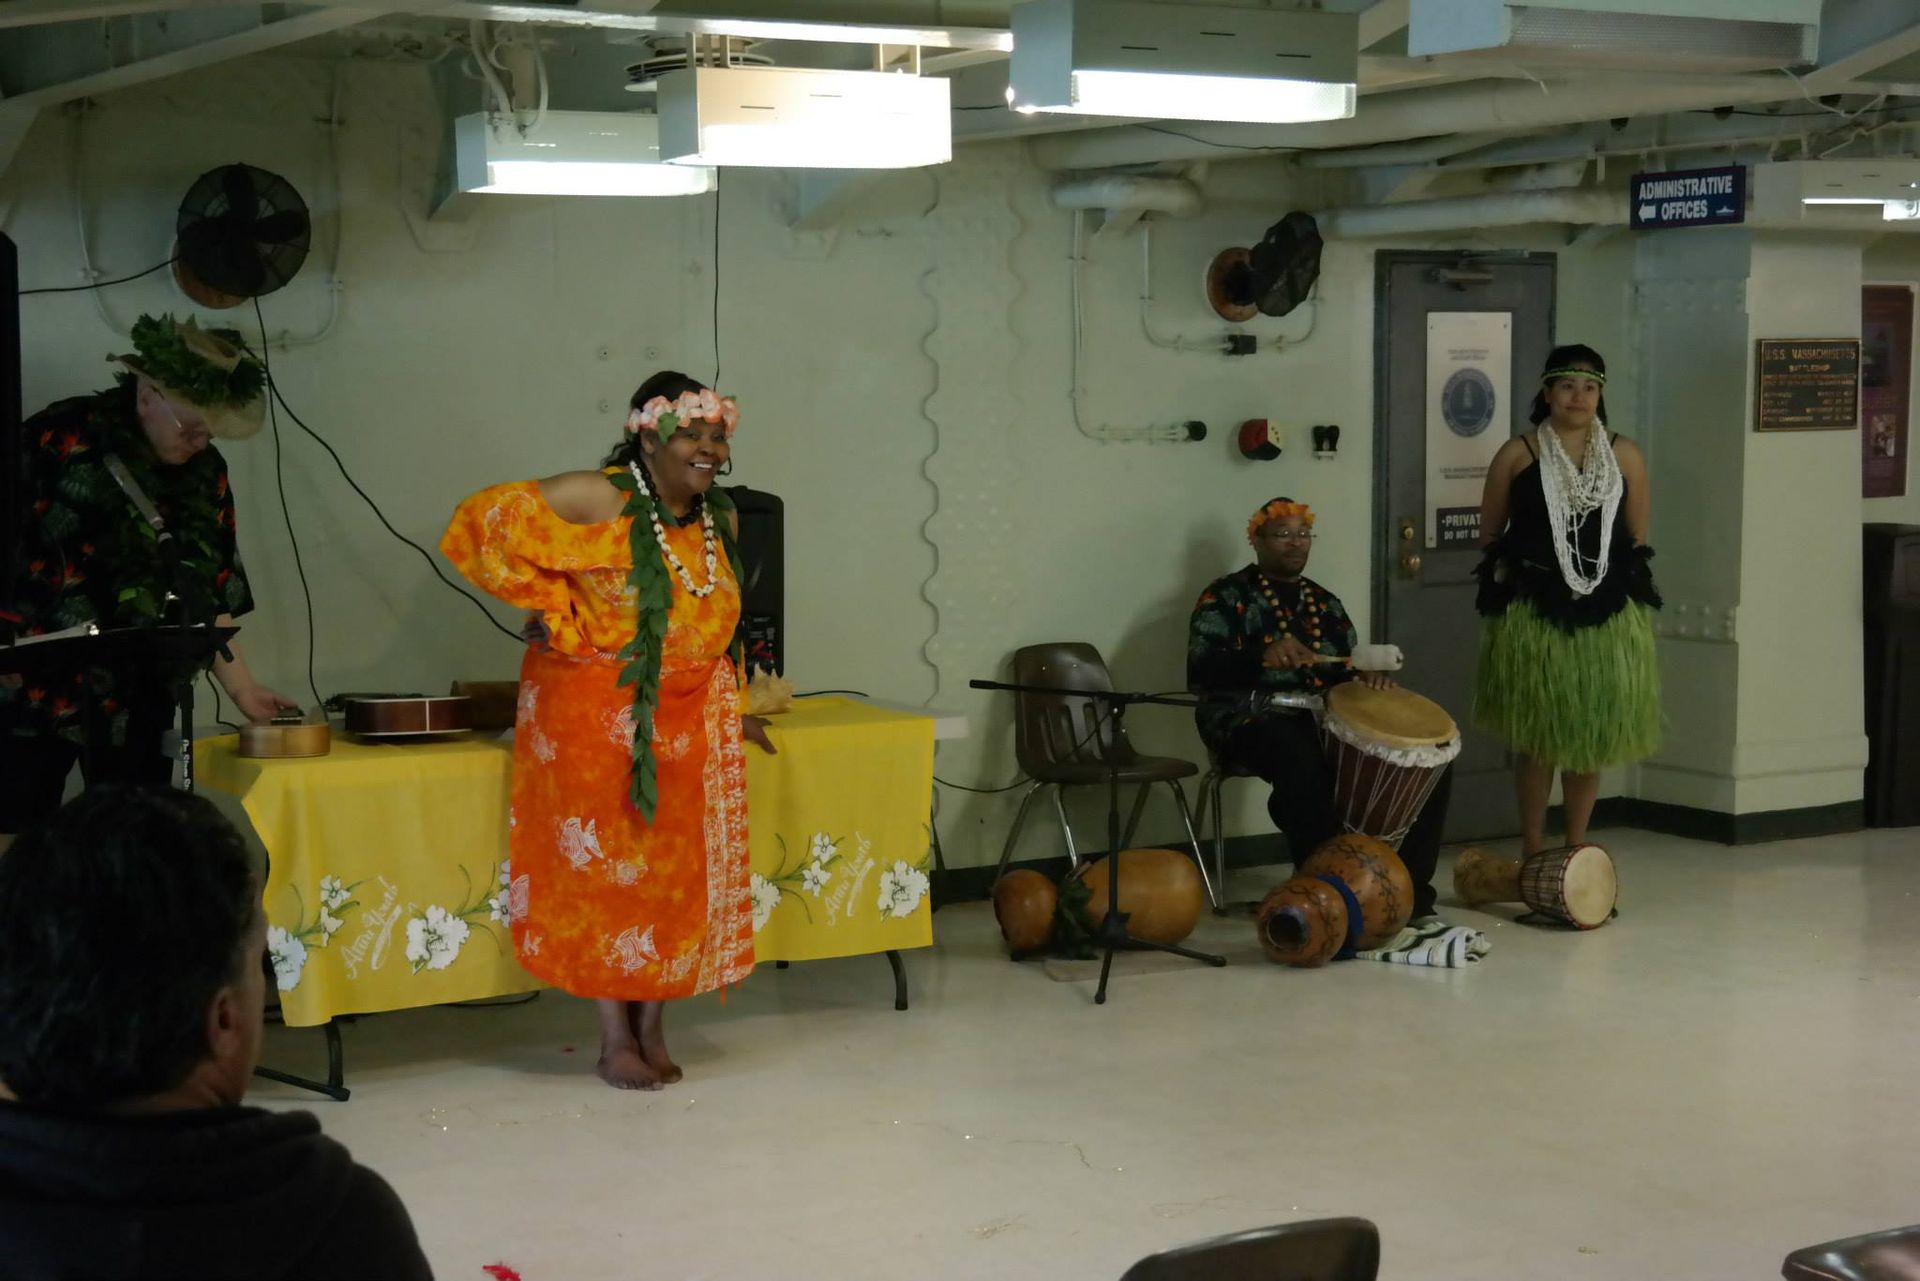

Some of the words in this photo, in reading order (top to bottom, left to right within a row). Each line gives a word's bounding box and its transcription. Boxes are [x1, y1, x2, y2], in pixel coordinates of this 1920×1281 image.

[1638, 175, 1733, 200] ADMINISTRATIVE
[1661, 200, 1708, 220] OFFICES
[1444, 531, 1453, 540] DO
[1456, 530, 1468, 539] NOT
